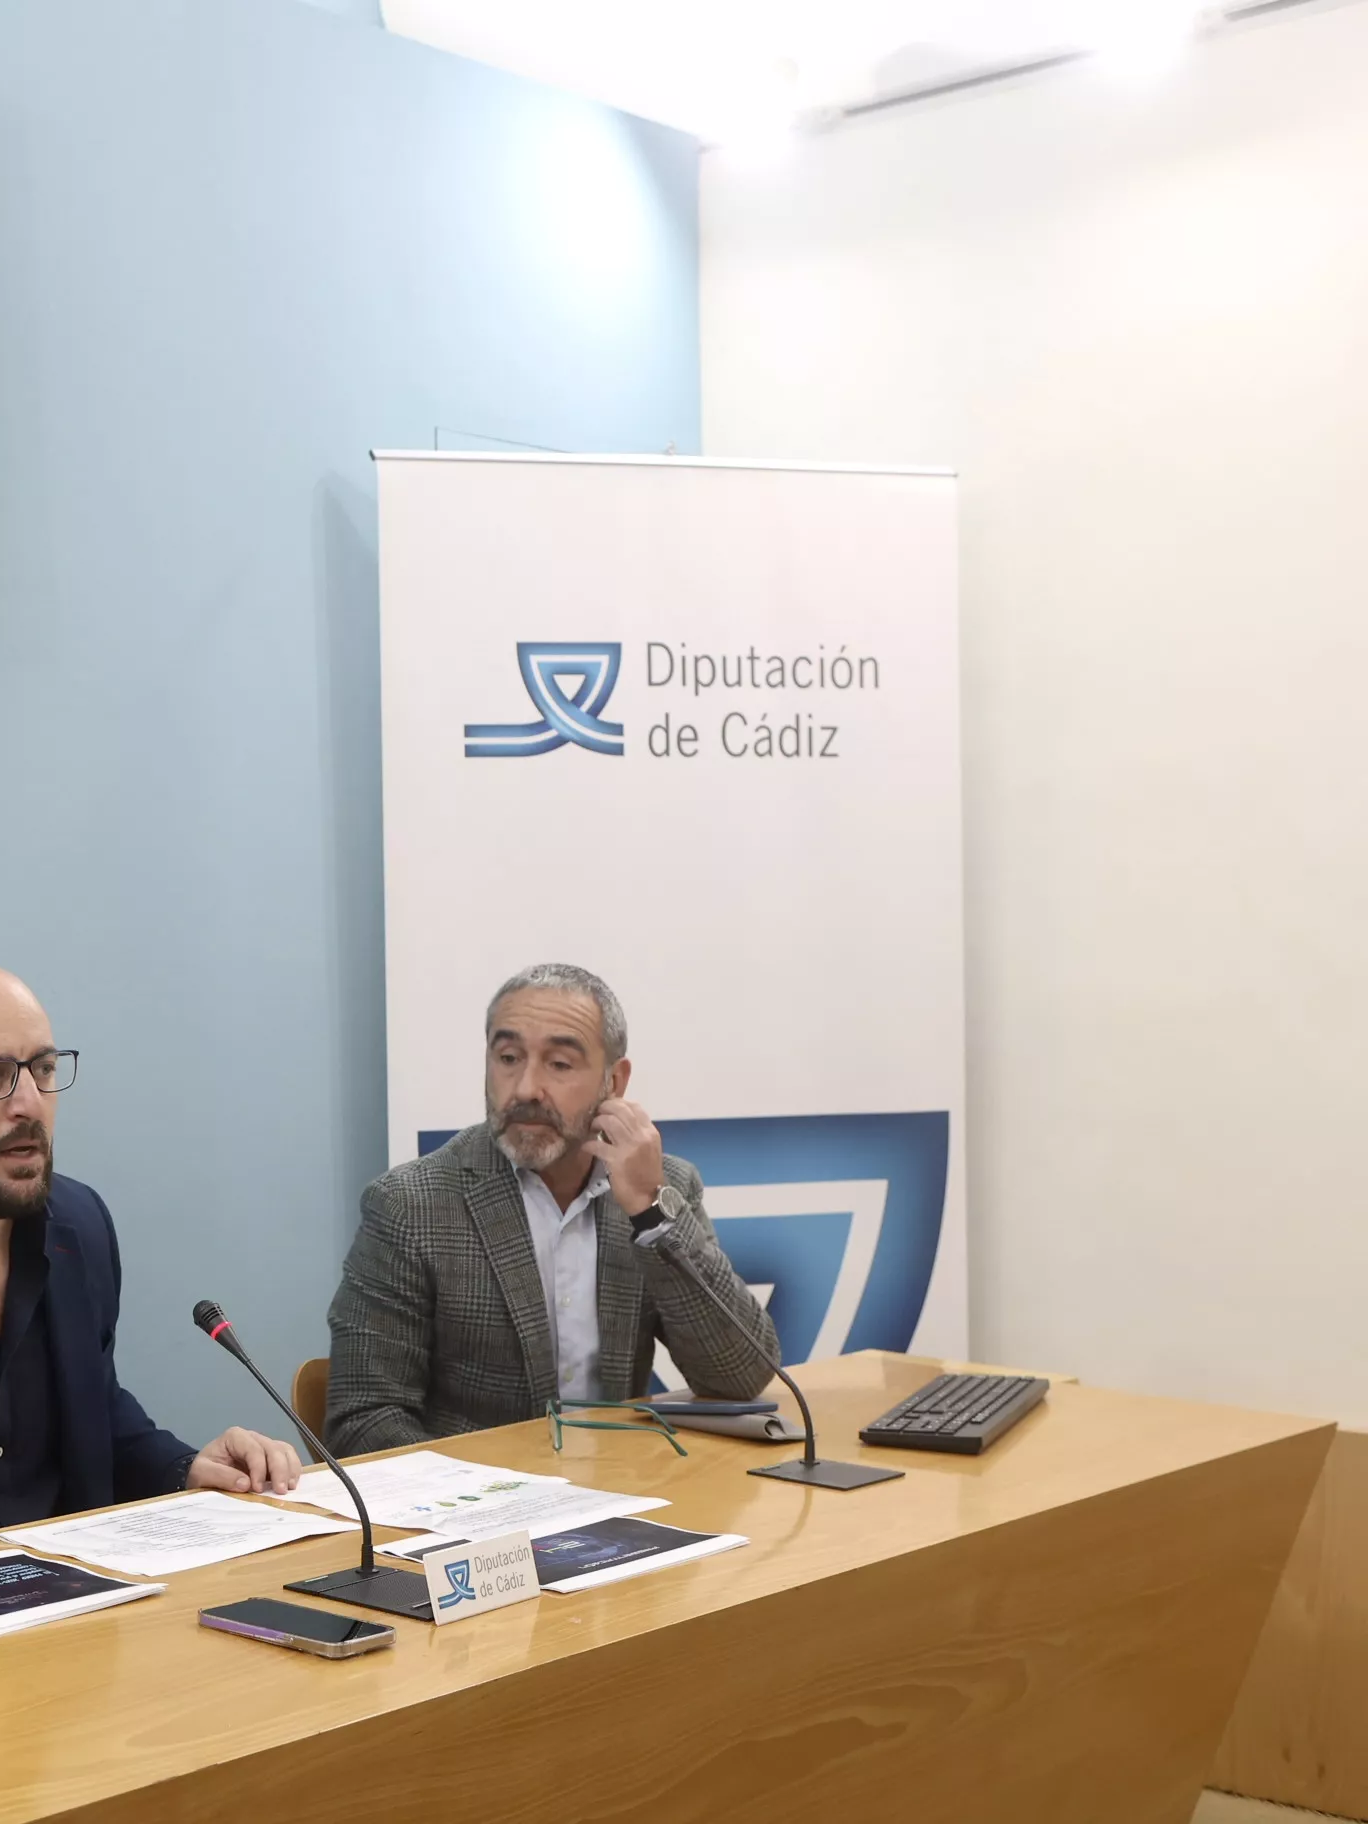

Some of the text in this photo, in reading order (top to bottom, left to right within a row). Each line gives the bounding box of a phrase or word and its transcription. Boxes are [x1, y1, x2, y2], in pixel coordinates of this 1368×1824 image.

[646, 641, 880, 697] Diputación
[648, 711, 840, 758] de Cádiz
[474, 1544, 530, 1574] Diputación
[479, 1571, 526, 1598] de Cádiz
